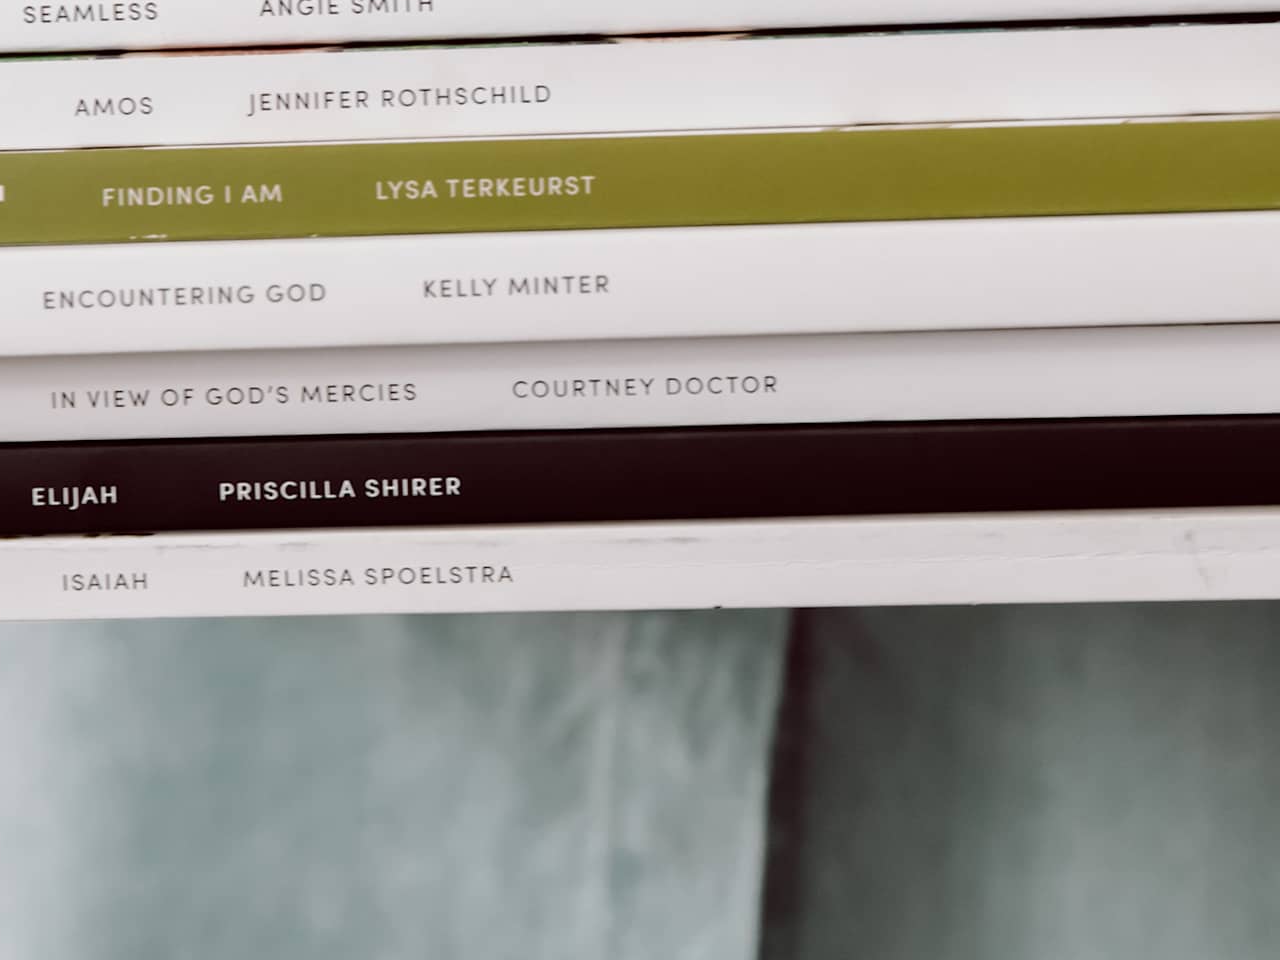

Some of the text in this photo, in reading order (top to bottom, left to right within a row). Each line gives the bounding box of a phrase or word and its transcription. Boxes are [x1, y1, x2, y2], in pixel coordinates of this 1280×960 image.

[23, 1, 158, 24] SEAMLESS
[75, 96, 153, 116] AMOS
[247, 84, 551, 117] JENNIFER ROTHSCHILD
[102, 183, 283, 207] FINDING I AM
[375, 175, 596, 201] LYSA TERKEURST
[43, 282, 326, 310] ENCOUNTERING GOD
[423, 274, 609, 299] KELLY MINTER
[52, 391, 75, 409] IN
[87, 389, 150, 408] VIEW
[161, 388, 194, 407] OF
[301, 383, 417, 403] MERCIES
[512, 375, 777, 399] COURTNEY DOCTOR
[31, 485, 117, 511] ELIJAH
[219, 476, 461, 501] PRISCILLA SHIRER
[63, 573, 148, 592] ISAIAH
[243, 565, 513, 588] MELISSA SPOELSTRA
